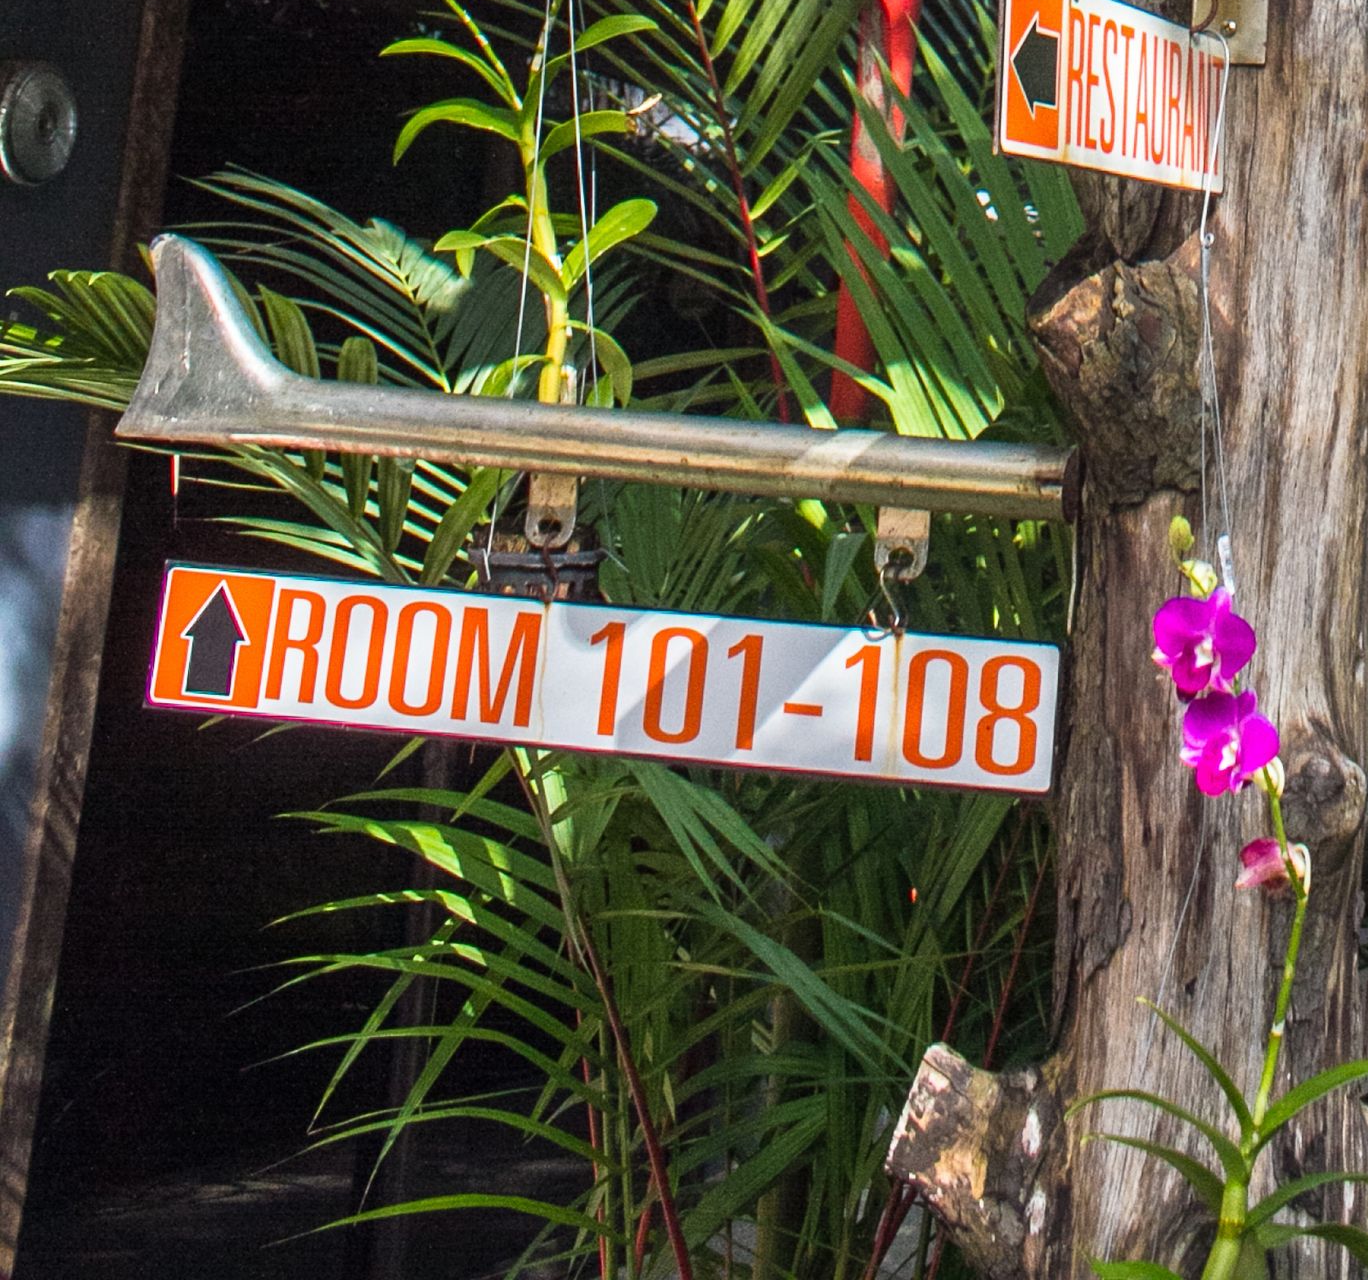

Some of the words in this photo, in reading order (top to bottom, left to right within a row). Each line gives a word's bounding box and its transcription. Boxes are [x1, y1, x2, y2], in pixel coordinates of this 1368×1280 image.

[1066, 8, 1224, 176] RESTAURANT
[264, 588, 538, 728] ROOM
[589, 621, 1042, 776] 101-108
